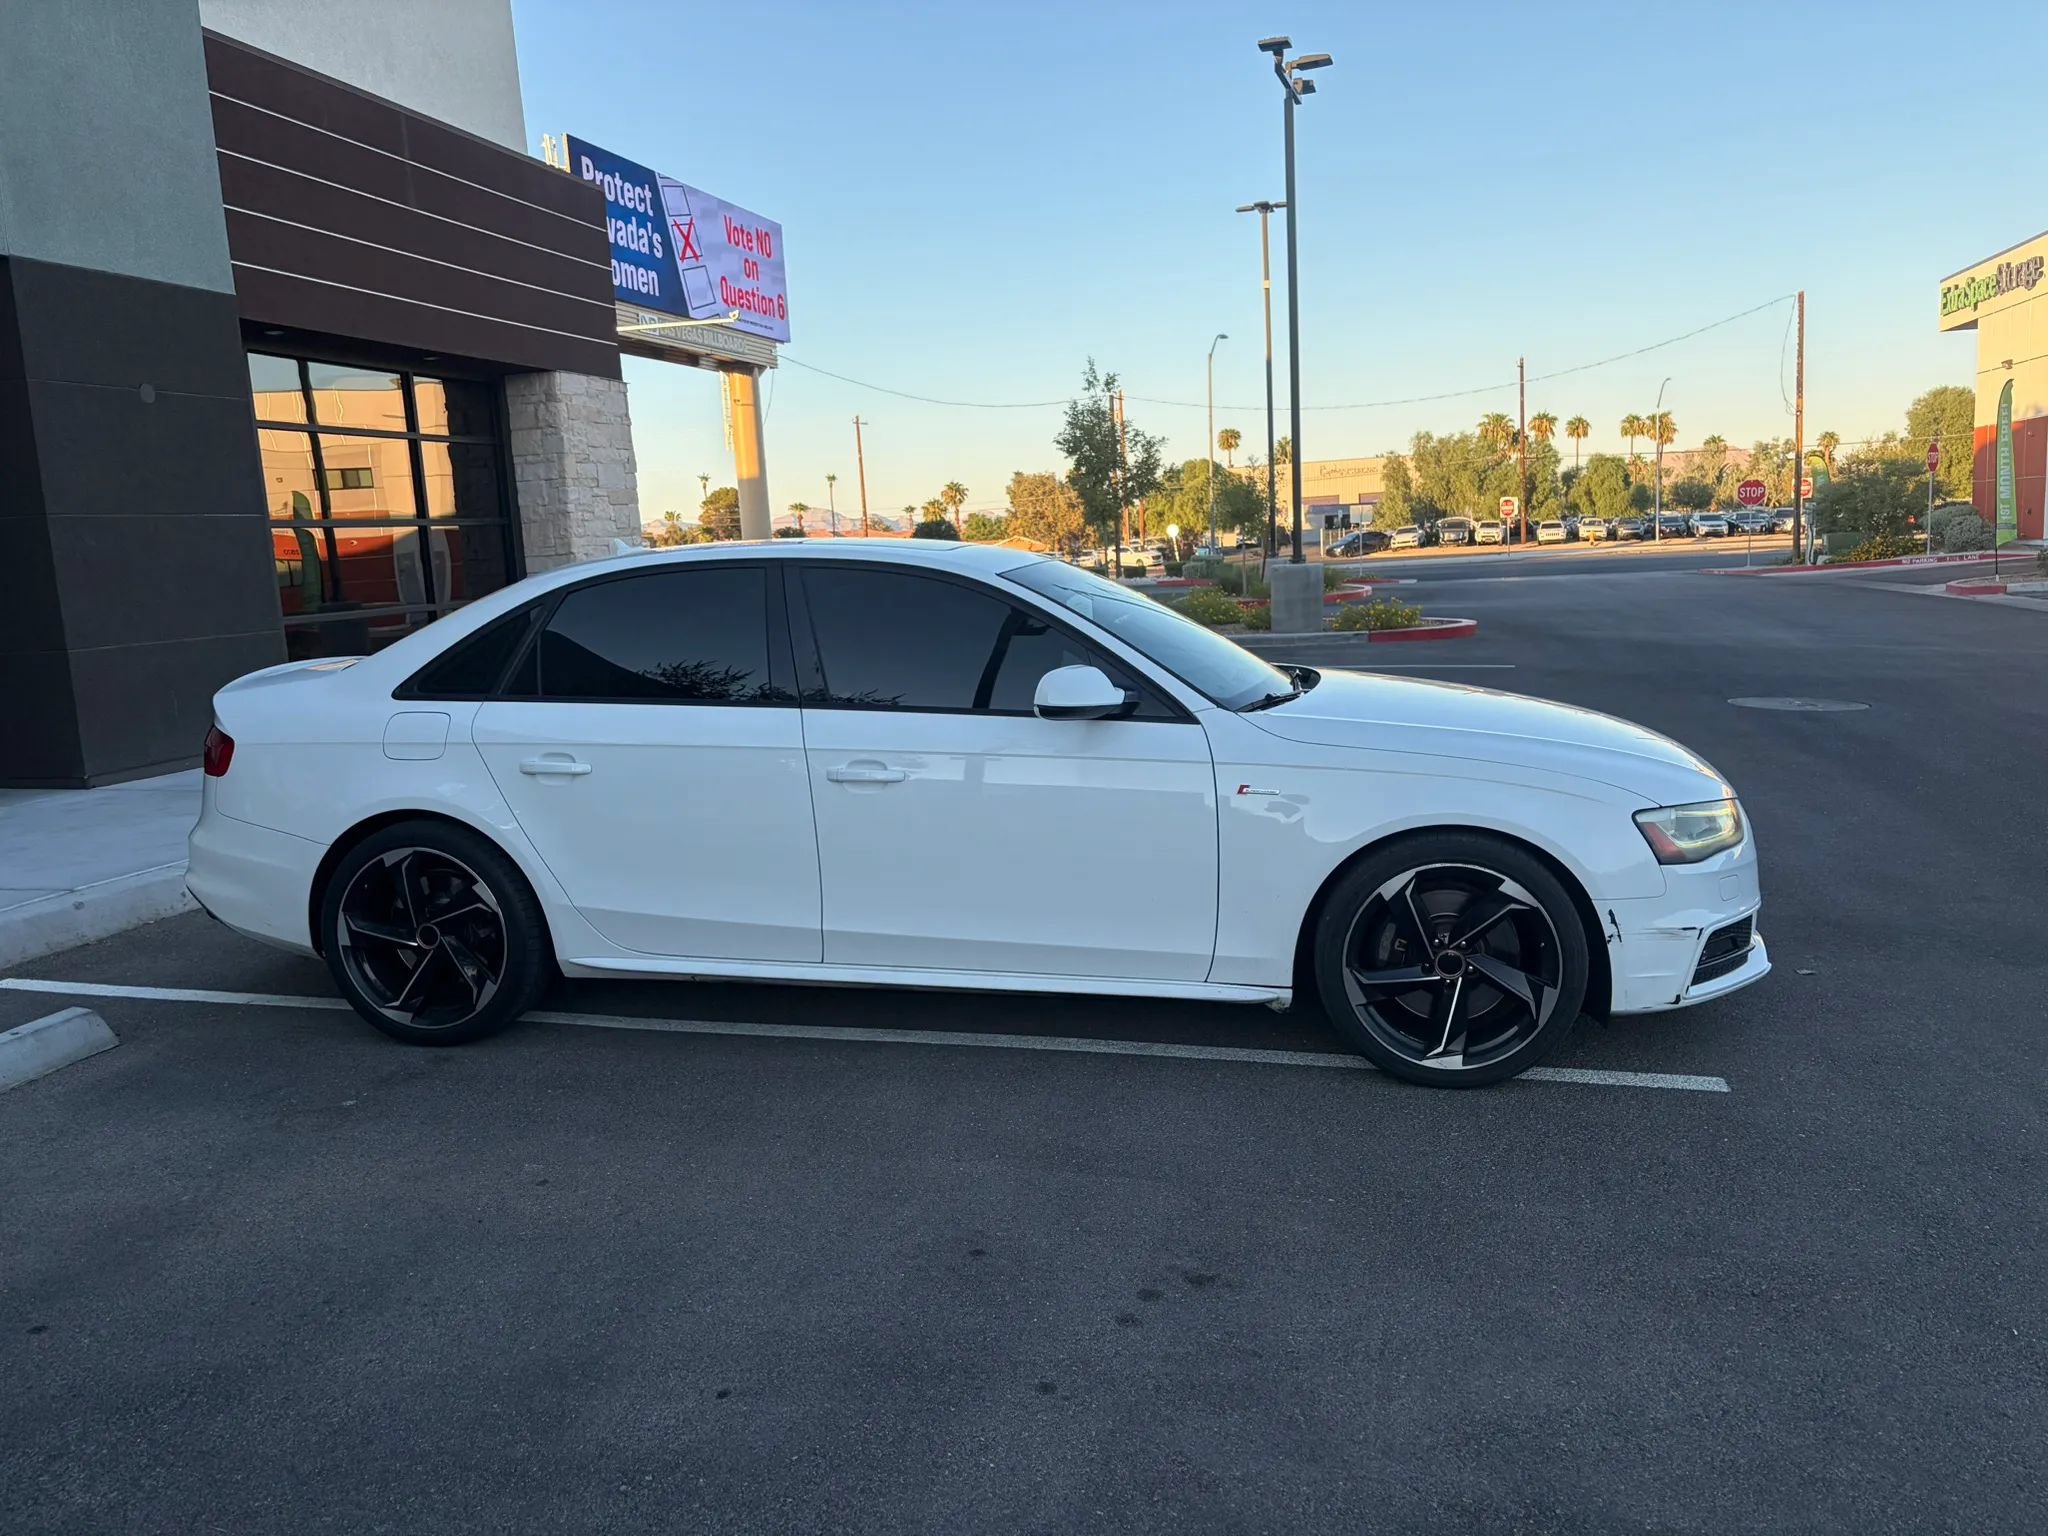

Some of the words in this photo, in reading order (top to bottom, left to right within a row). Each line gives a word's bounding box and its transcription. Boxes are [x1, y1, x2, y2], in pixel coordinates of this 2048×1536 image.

[606, 216, 663, 259] vada's
[723, 214, 753, 252] Vote
[755, 227, 773, 259] NO
[611, 259, 660, 297] omen
[743, 258, 759, 282] on
[720, 275, 775, 318] Question
[777, 293, 785, 321] 6
[1928, 451, 1938, 464] STOP
[1999, 447, 2011, 499] MONTH
[1739, 487, 1764, 498] STOP
